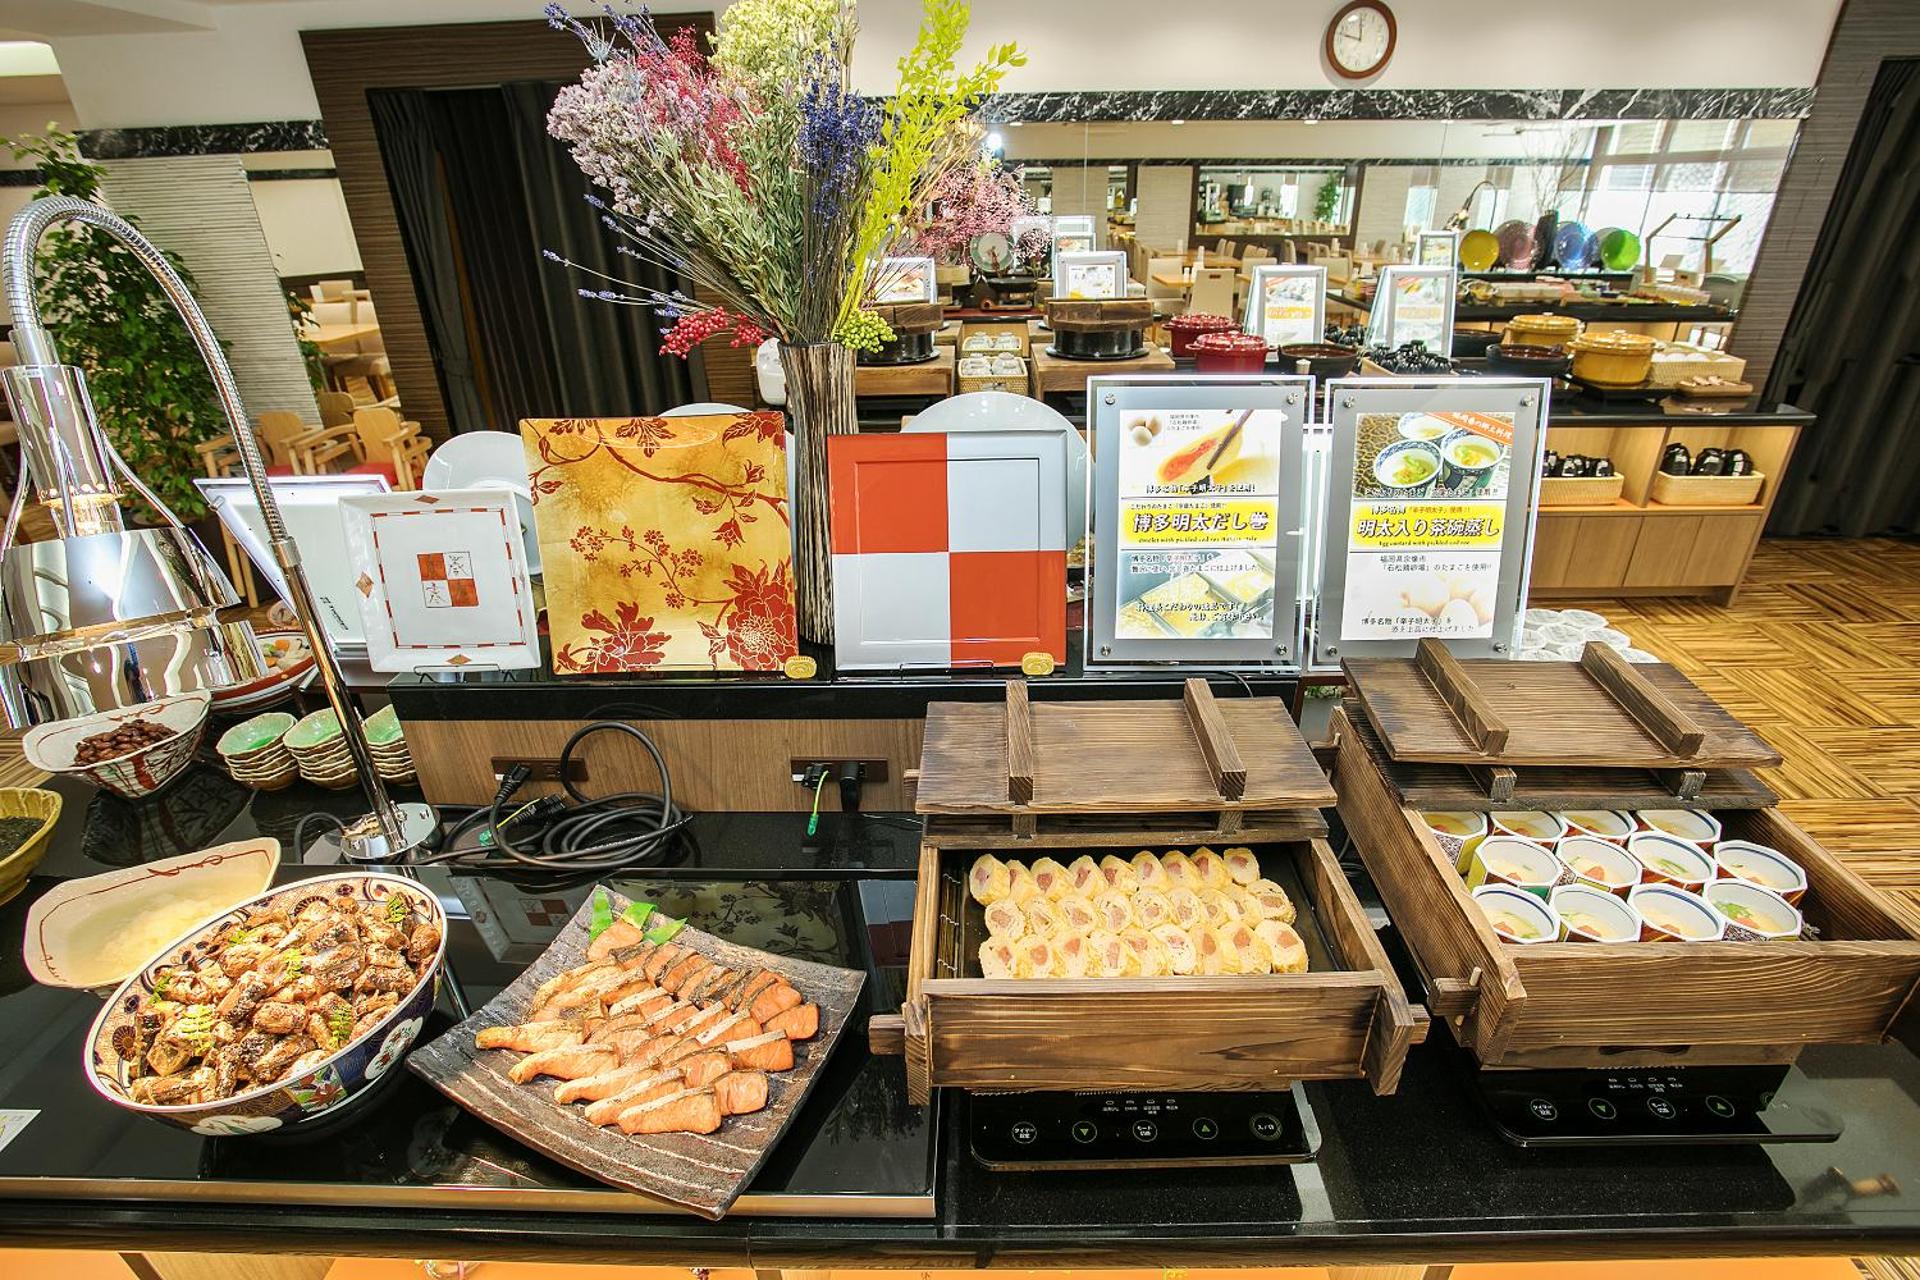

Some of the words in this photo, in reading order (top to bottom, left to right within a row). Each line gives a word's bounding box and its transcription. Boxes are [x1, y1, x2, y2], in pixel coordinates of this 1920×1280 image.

[1133, 511, 1269, 533] 博多明太だし巻
[1357, 518, 1500, 537] 明太入り茶碗蒸し
